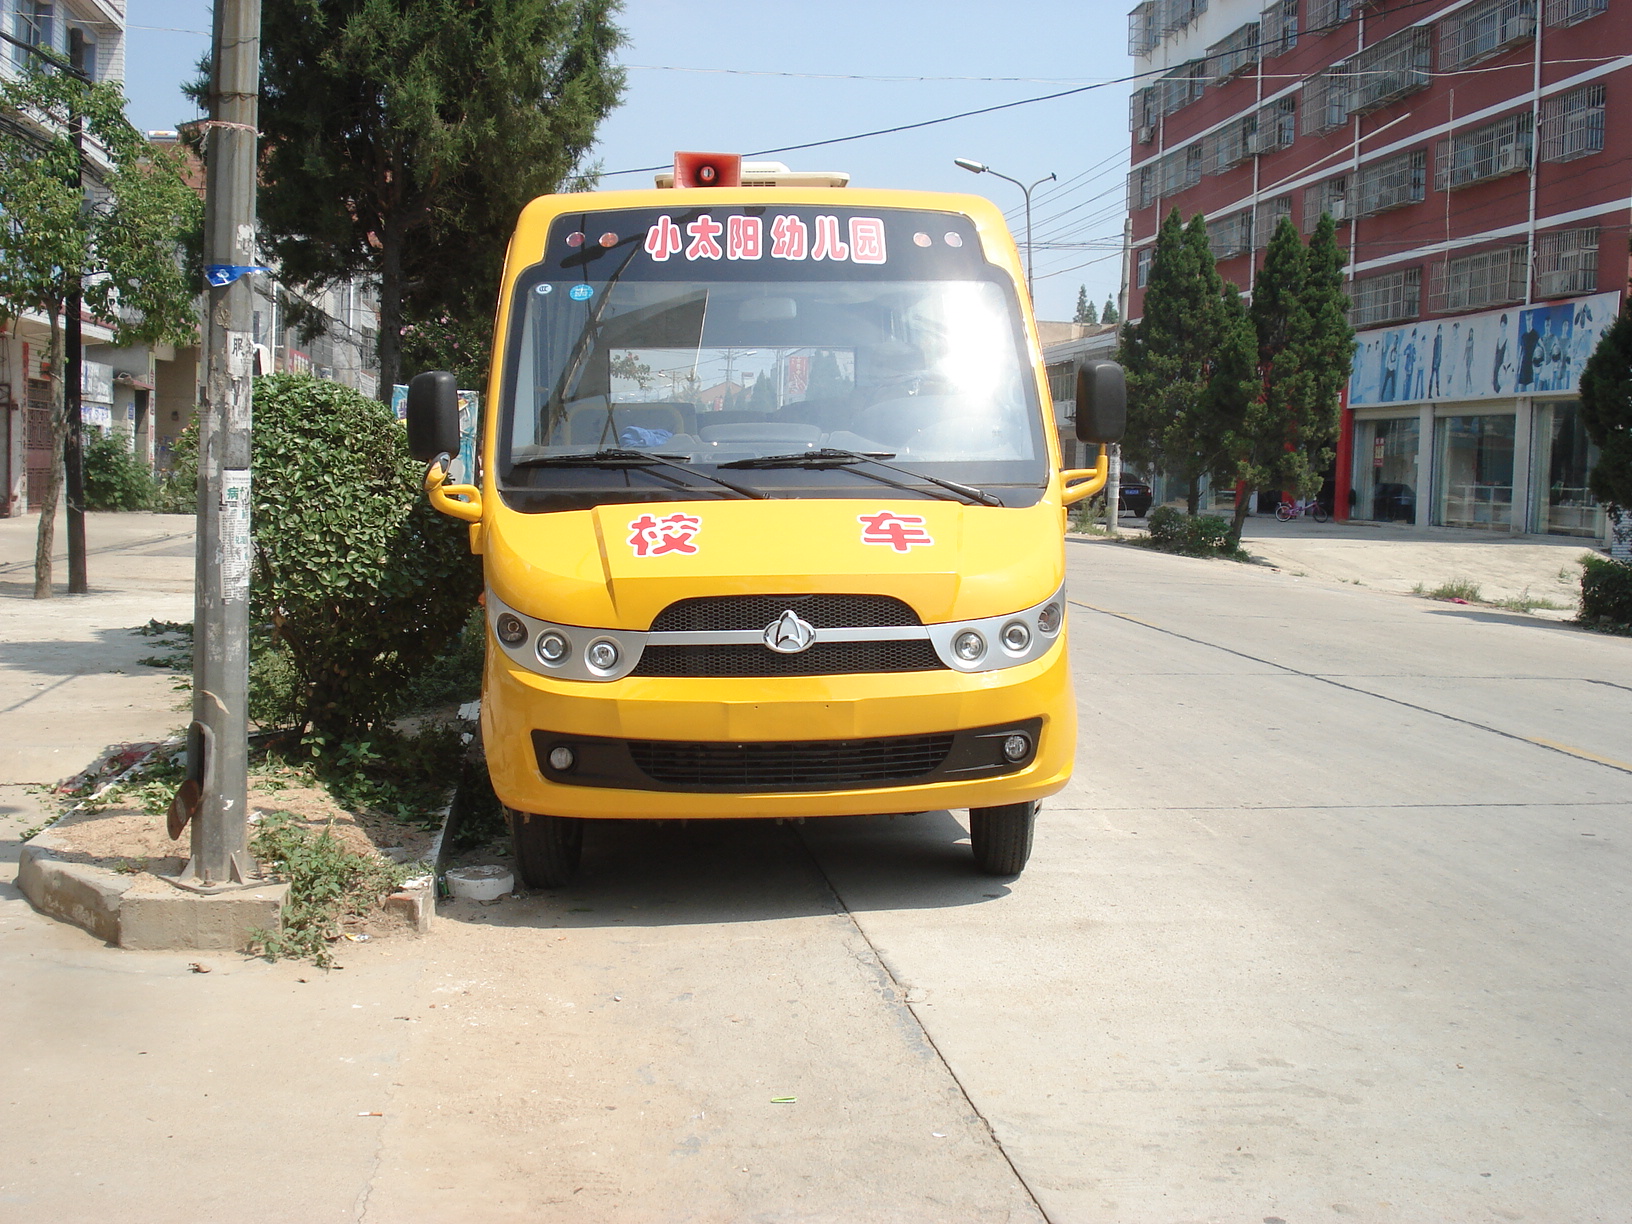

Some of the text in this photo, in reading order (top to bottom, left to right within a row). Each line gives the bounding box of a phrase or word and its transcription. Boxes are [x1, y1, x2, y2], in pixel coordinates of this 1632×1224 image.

[644, 214, 887, 264] 小太阳幼儿园
[627, 510, 933, 557] 校 车
